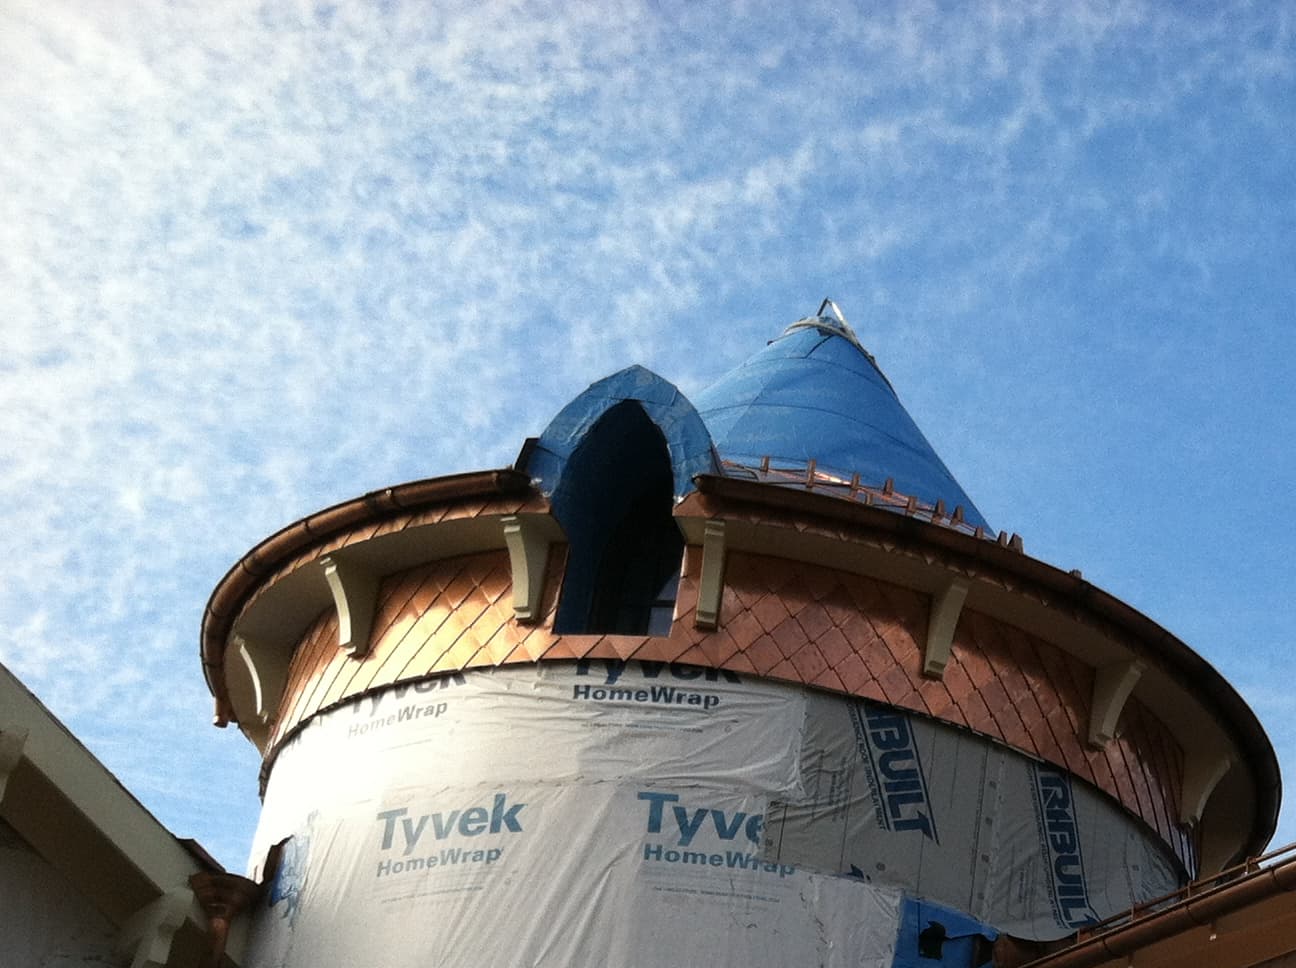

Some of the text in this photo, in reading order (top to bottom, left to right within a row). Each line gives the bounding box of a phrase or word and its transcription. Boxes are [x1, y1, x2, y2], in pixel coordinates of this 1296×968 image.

[573, 684, 720, 709] HomeWrap
[347, 702, 448, 739] HomeWrap
[377, 794, 527, 855] Tyvek
[376, 846, 501, 878] HomeWrap
